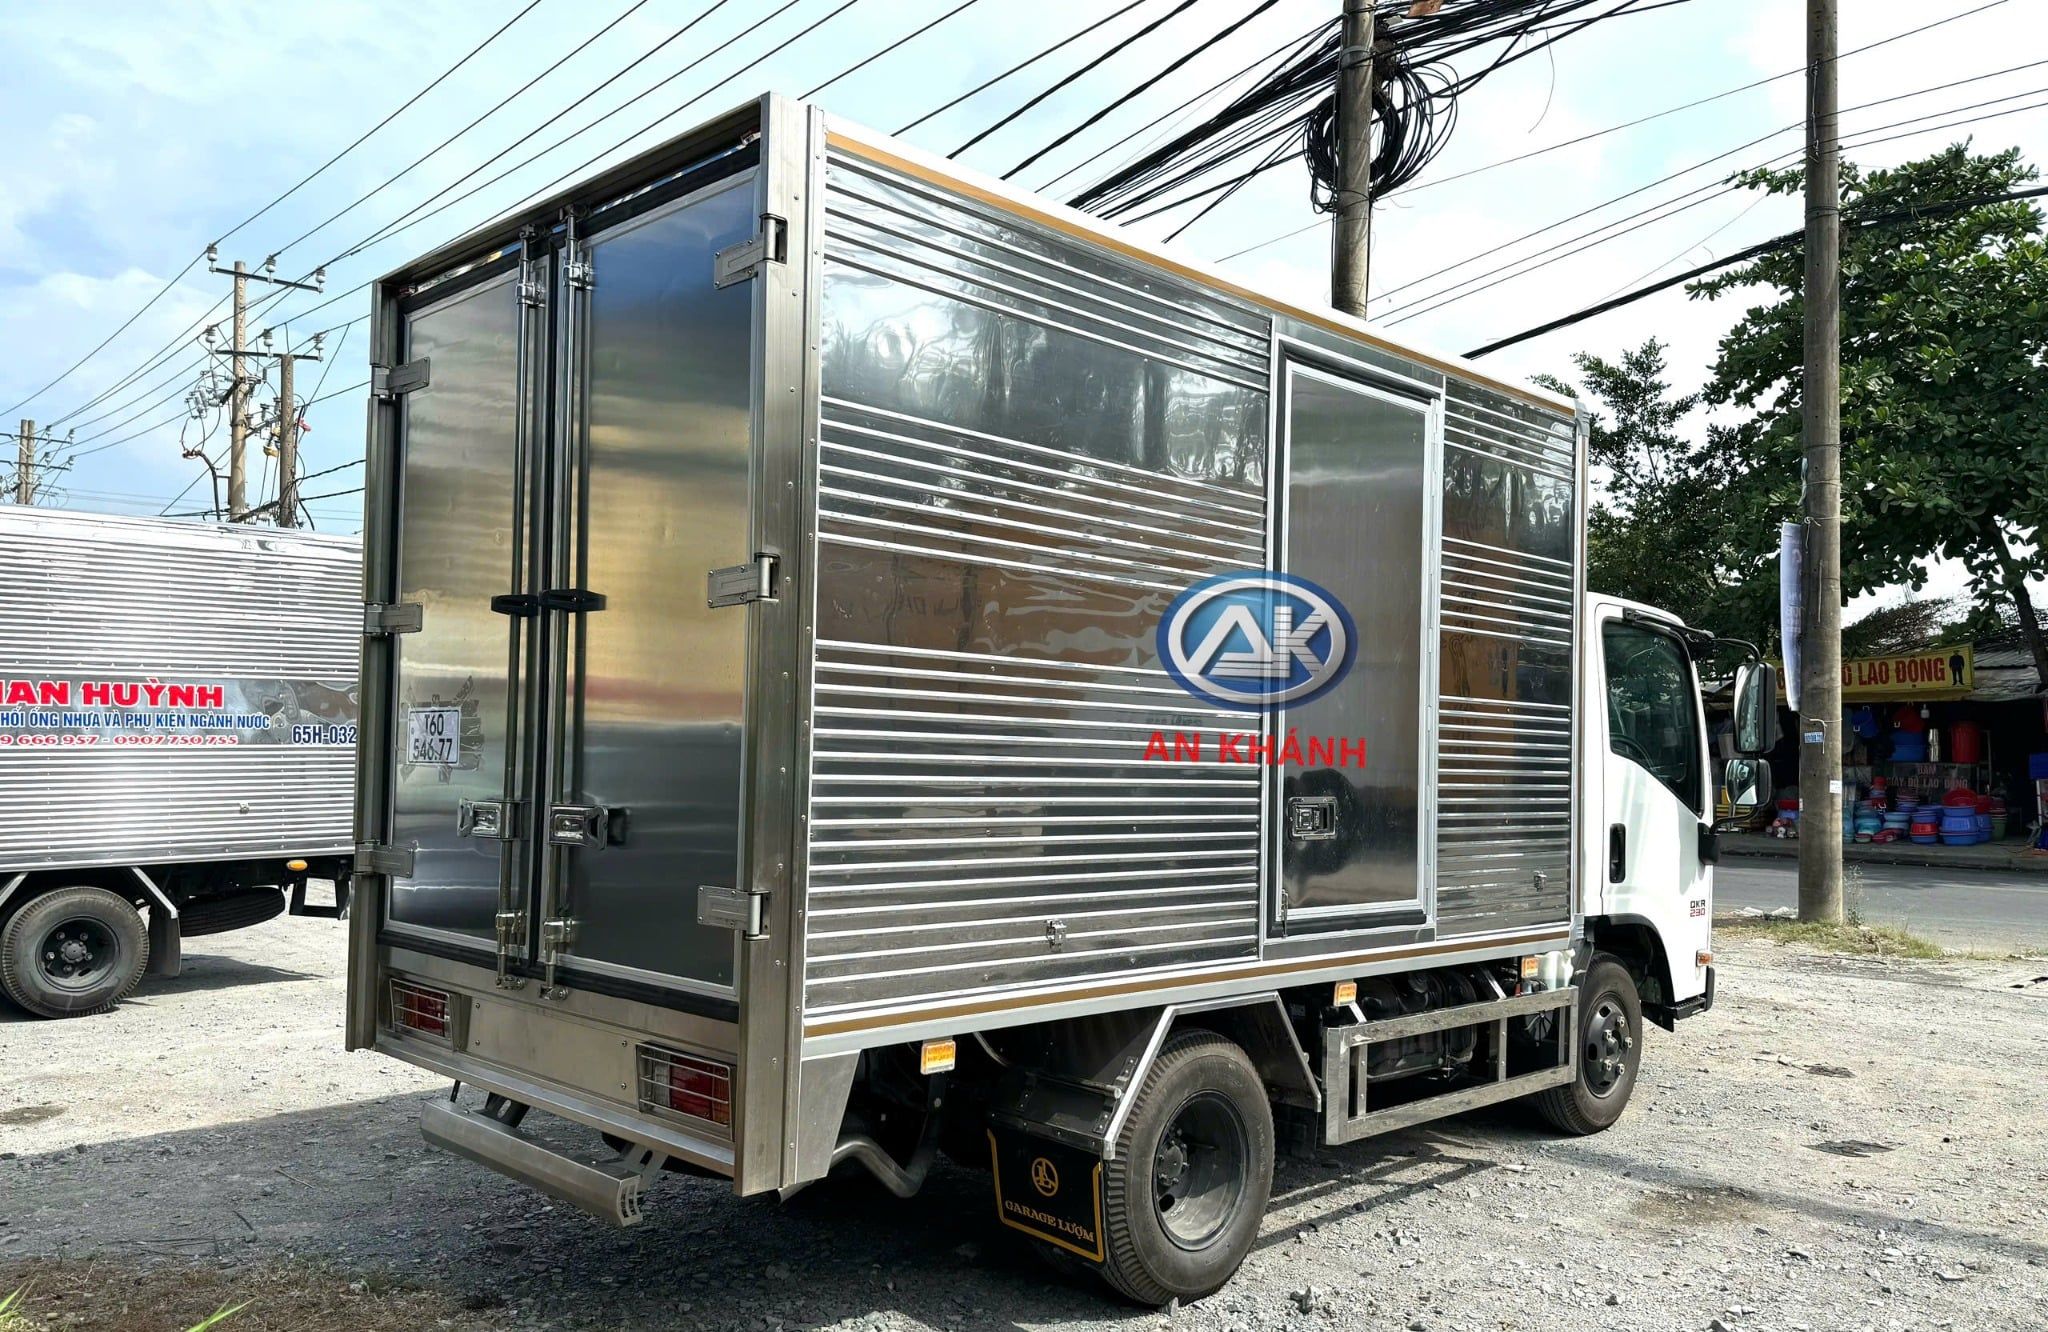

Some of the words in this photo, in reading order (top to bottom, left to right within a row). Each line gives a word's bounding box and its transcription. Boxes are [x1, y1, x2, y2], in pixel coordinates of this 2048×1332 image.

[1856, 660, 1890, 686] LAO
[1895, 655, 1945, 687] ĐỘNG
[80, 677, 223, 708] HUỲNH
[0, 706, 24, 727] HỐI
[30, 706, 58, 727] ỐNG
[63, 711, 101, 730] NHỰA
[104, 709, 121, 727] VÀ
[125, 713, 151, 731] PHỤ
[156, 711, 186, 731] KIỆN
[190, 710, 233, 728] NGÀNH
[237, 711, 270, 728] NƯỚC
[424, 713, 444, 736] T60
[18, 735, 57, 745] 666
[62, 736, 98, 745] 957
[114, 736, 165, 745] 0907
[168, 736, 202, 745] 750
[206, 737, 237, 745] 755
[1690, 908, 1705, 917] 230
[1005, 1200, 1056, 1227] GARAGE
[1058, 1219, 1094, 1242] LƯỢM
